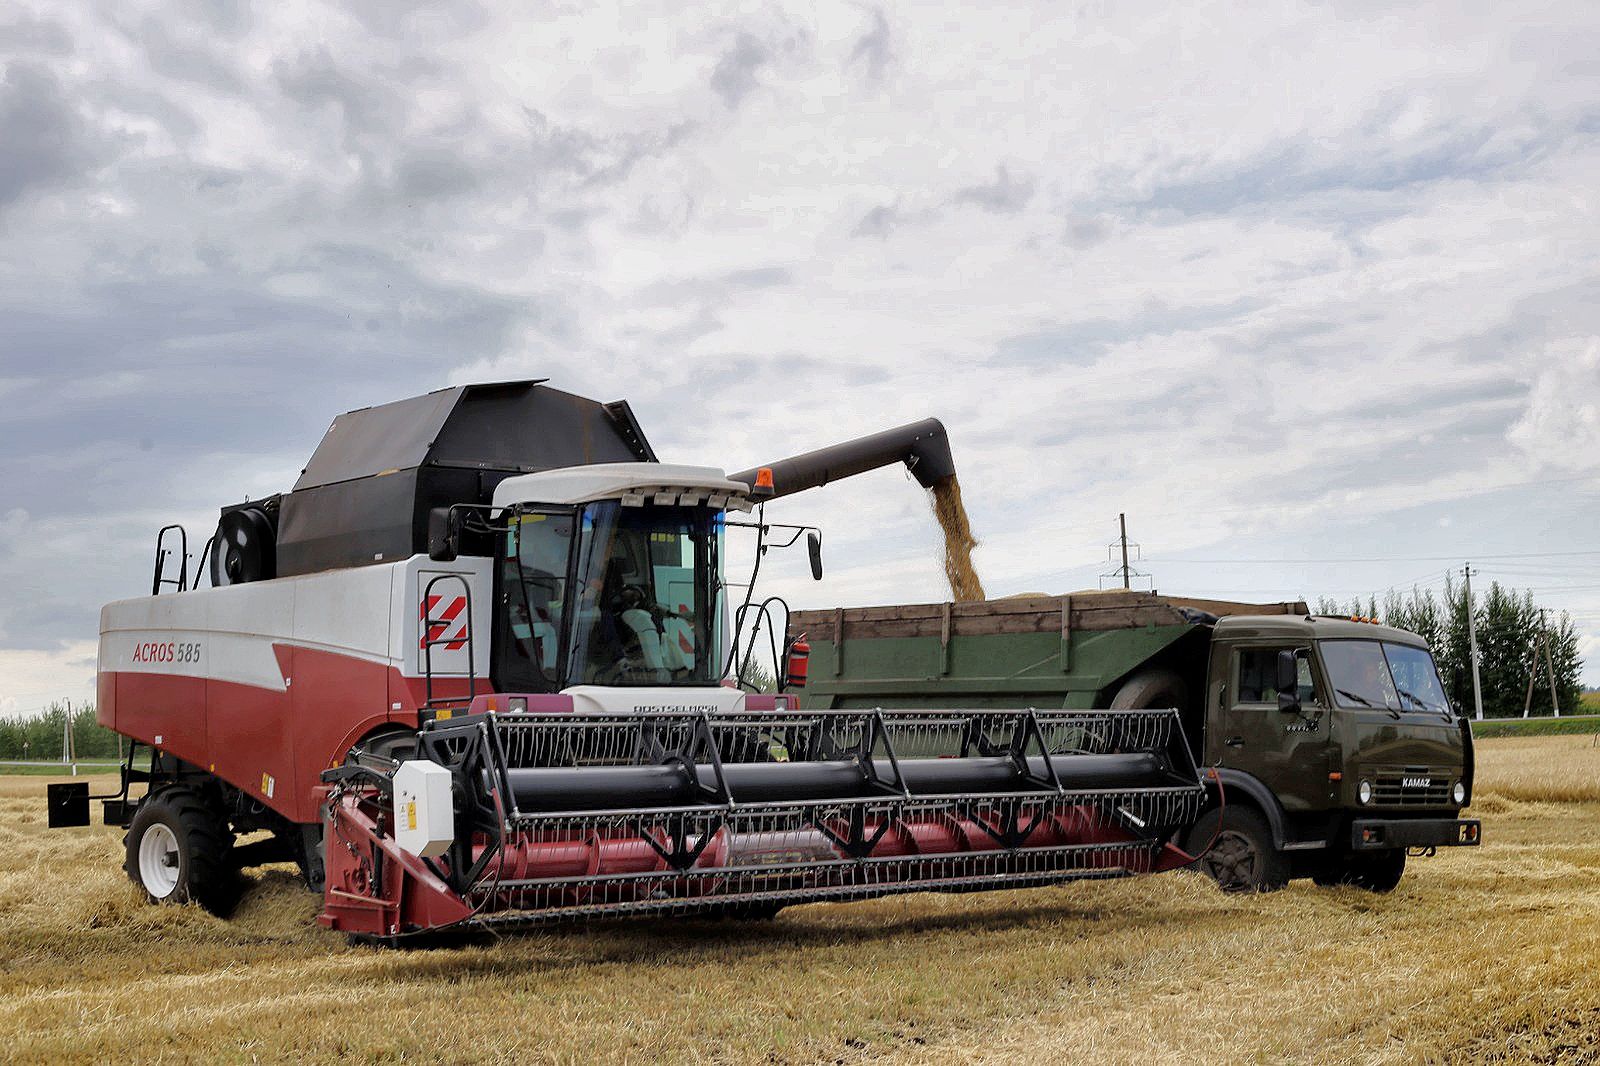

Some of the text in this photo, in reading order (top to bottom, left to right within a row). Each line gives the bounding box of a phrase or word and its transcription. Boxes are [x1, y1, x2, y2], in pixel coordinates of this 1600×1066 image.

[133, 642, 201, 663] ACROS 585
[1402, 777, 1431, 788] KAMAZ
